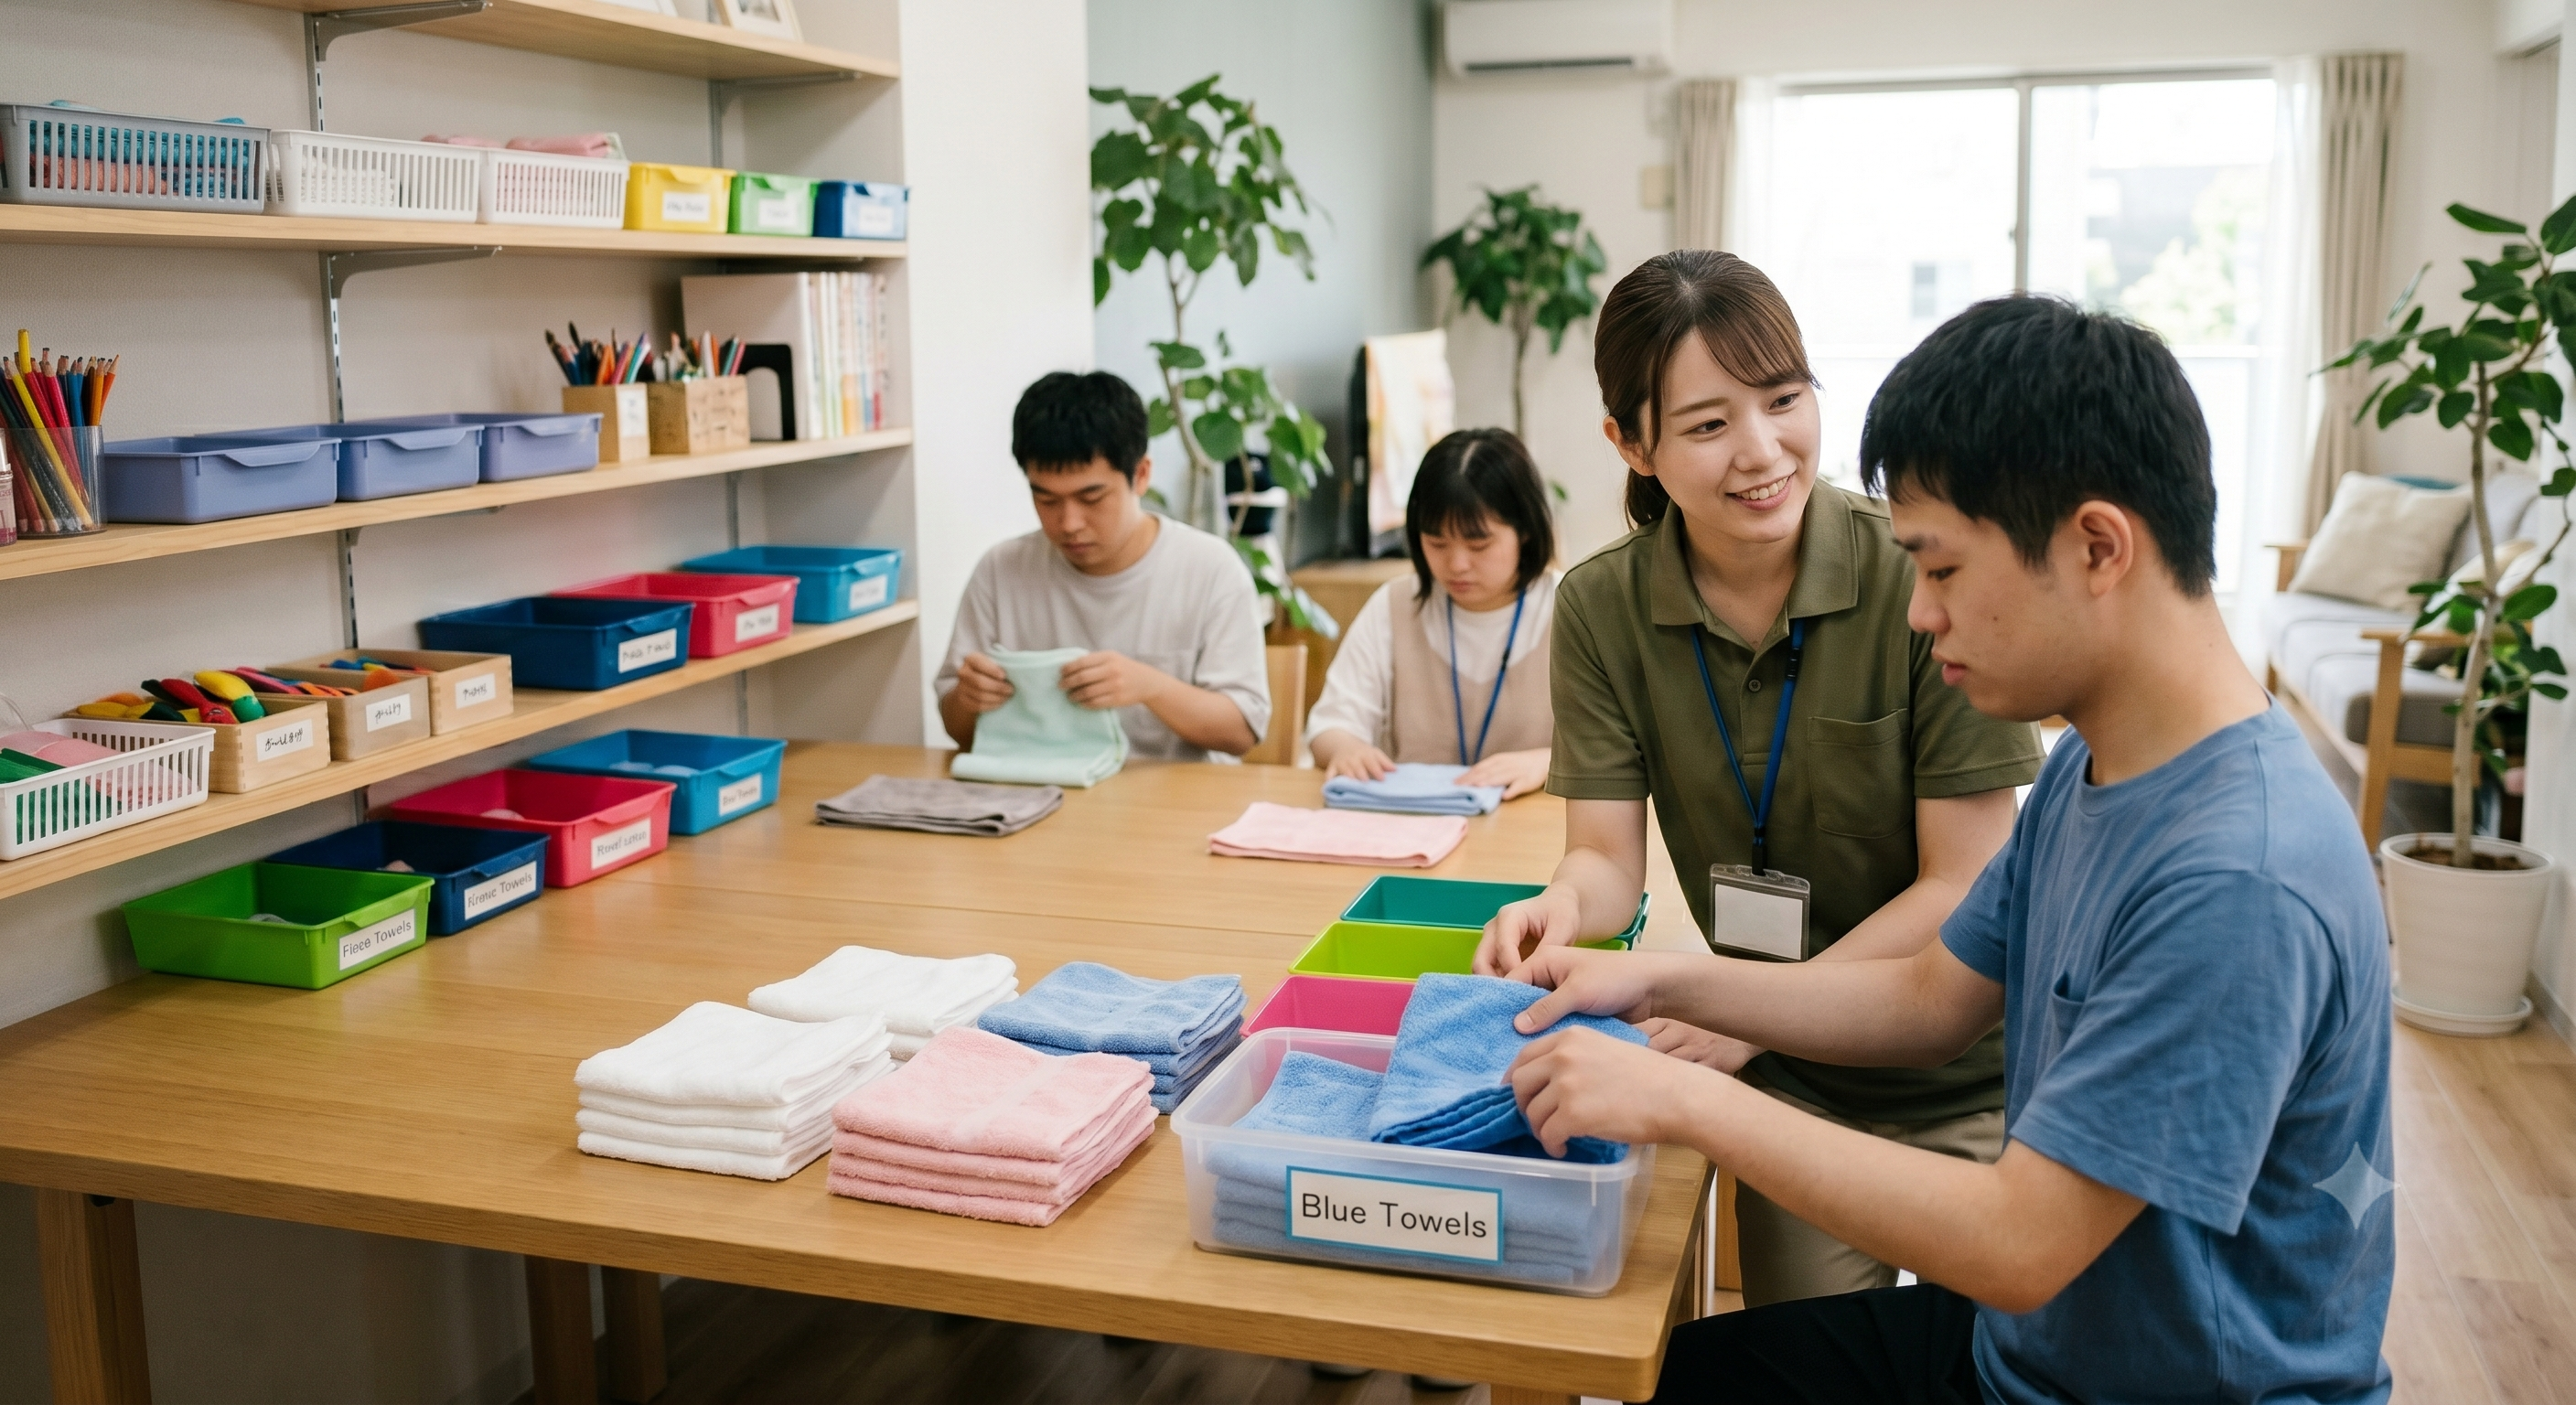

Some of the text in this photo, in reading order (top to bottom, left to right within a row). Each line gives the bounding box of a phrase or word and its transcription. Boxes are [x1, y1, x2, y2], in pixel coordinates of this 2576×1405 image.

[374, 920, 412, 944] Towels
[1302, 1192, 1487, 1238] Blue Towels
